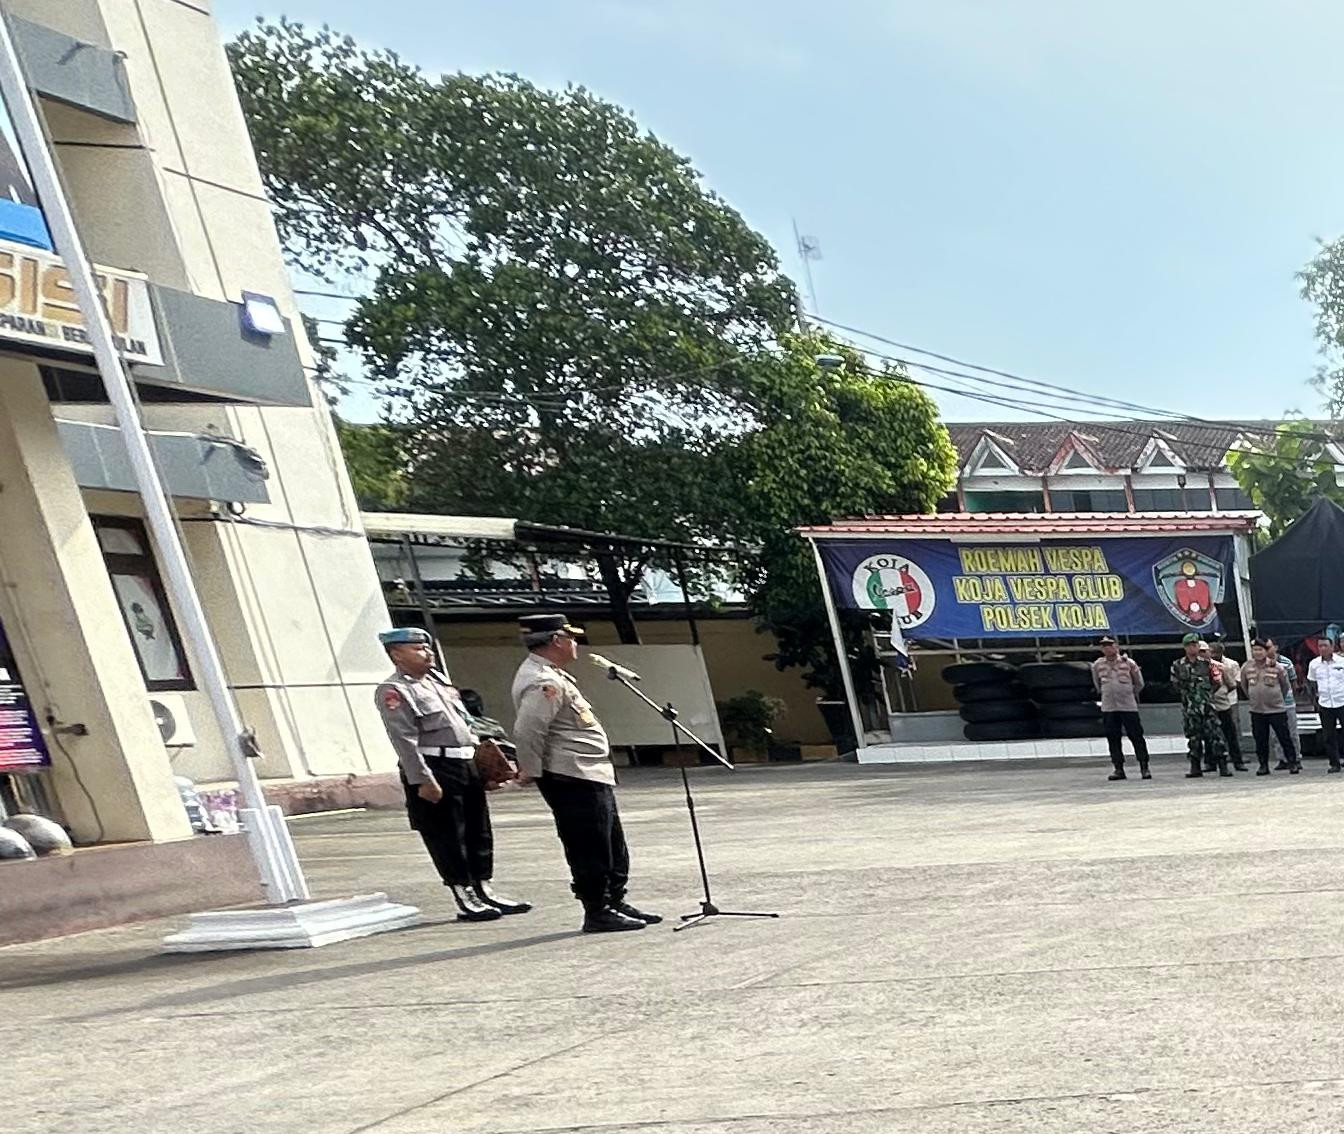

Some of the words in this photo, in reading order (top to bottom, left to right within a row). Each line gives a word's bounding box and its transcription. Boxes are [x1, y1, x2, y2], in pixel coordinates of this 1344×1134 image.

[960, 547, 1043, 574] ROEMAH
[1042, 546, 1108, 574] VESPA
[953, 576, 1009, 603] KOJA
[1008, 576, 1073, 602] VESPA
[1072, 575, 1124, 602] CLUB
[980, 604, 1057, 632] POLSEK
[1055, 603, 1109, 631] KOJA
